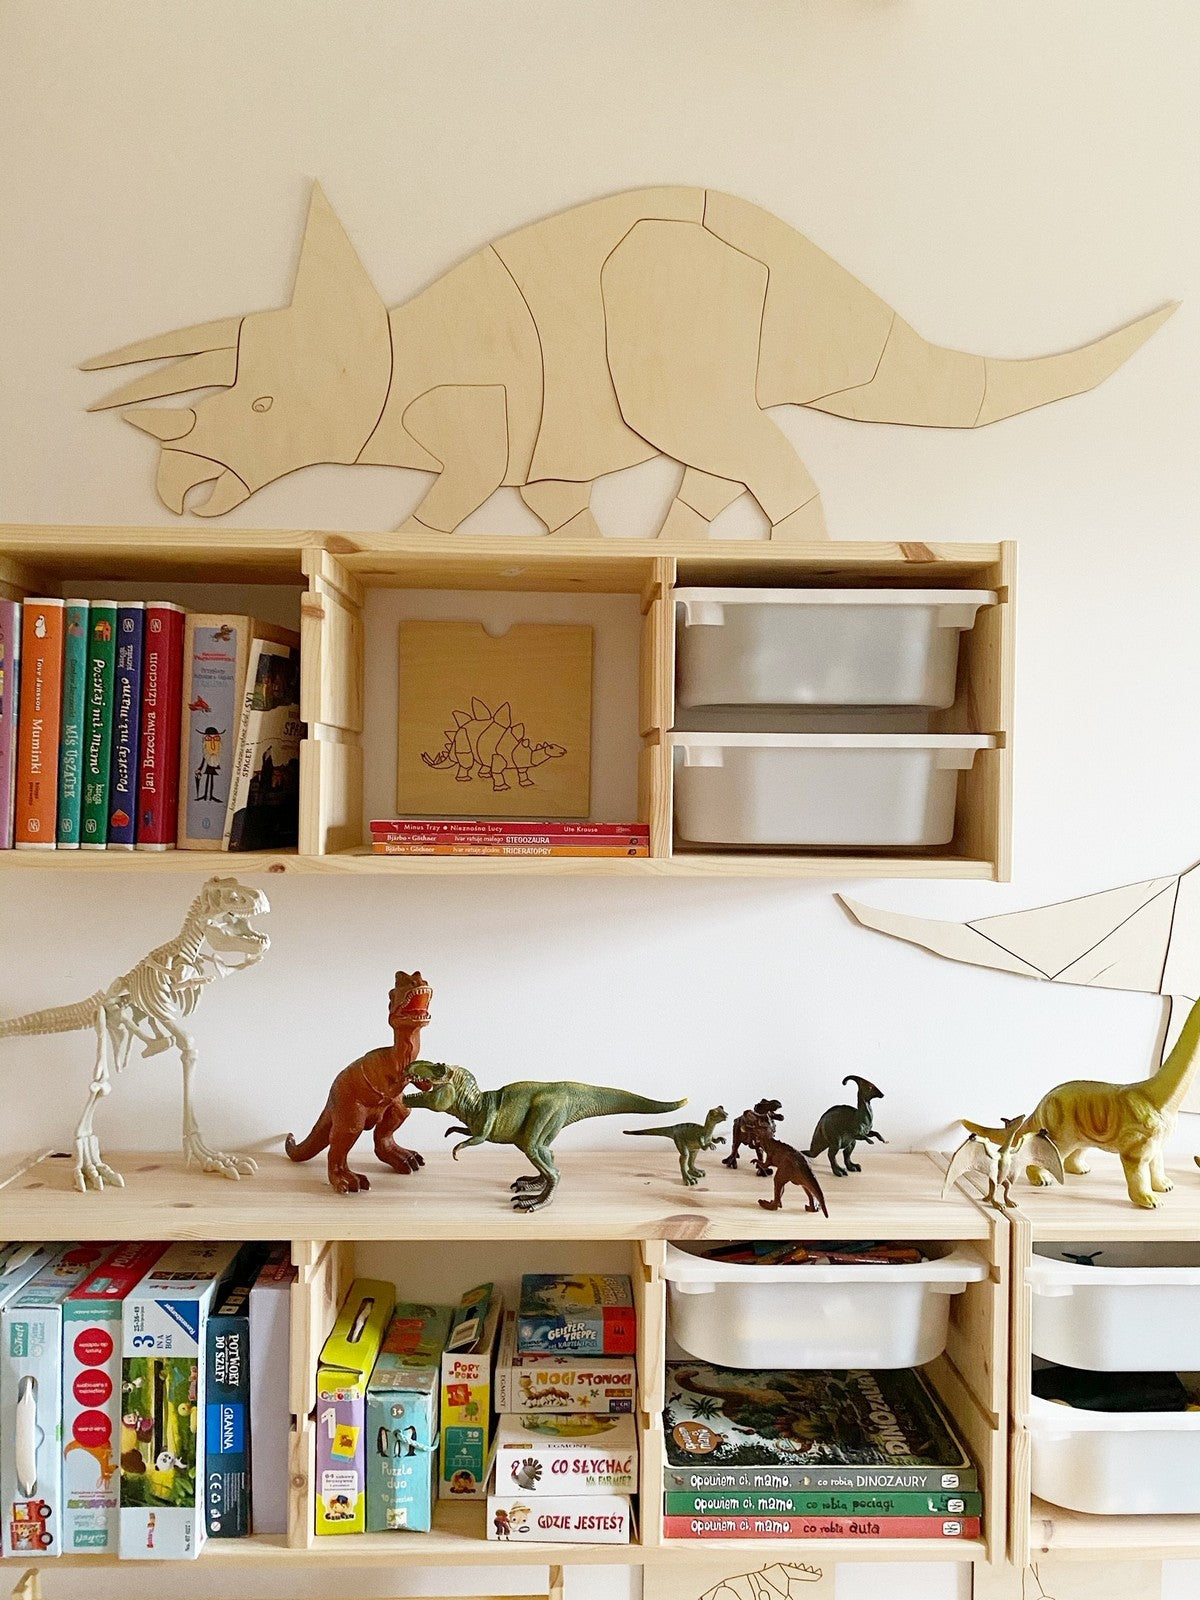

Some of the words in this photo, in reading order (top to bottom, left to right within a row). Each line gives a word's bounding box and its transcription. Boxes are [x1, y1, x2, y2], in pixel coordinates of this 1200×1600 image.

[92, 659, 106, 706] Poczytaj
[147, 652, 158, 706] dzieciom
[121, 677, 131, 717] mamo
[30, 718, 42, 774] Muminki
[144, 712, 156, 767] Brzechwa
[89, 734, 100, 775] mamo
[64, 749, 77, 798] USZATEK
[116, 745, 129, 792] Poczytaj
[142, 772, 156, 793] Jan
[488, 825, 503, 833] Lucy
[164, 1303, 195, 1335] Ravensburger
[547, 1322, 586, 1341] GEISTER
[563, 1329, 597, 1341] TREPPE
[133, 1335, 154, 1348] 3
[215, 1336, 224, 1349] DO
[215, 1352, 224, 1384] SZAFY
[229, 1334, 239, 1387] POTWORY
[454, 1361, 480, 1372] PORY
[536, 1371, 576, 1386] NOGI
[577, 1373, 632, 1386] STONOGI
[392, 1408, 403, 1416] 3+
[224, 1407, 234, 1450] GRANNA
[381, 1461, 413, 1476] Puzzle
[551, 1459, 568, 1474] CO
[572, 1456, 632, 1474] SŁYCHAĆ
[387, 1477, 407, 1489] duo
[586, 1476, 596, 1485] NA
[690, 1473, 736, 1490] opowiem
[754, 1474, 792, 1489] mamo,
[830, 1477, 853, 1487] robią
[856, 1475, 928, 1488] DINOZAURY
[694, 1496, 740, 1513] opowiem
[758, 1497, 796, 1512] mamo,
[806, 1501, 818, 1509] co
[822, 1498, 847, 1510] robią
[537, 1515, 571, 1529] GDZIE
[574, 1512, 624, 1533] JESTEŚ?
[690, 1519, 736, 1535] opowiem
[754, 1520, 793, 1534] mamo,
[803, 1525, 816, 1533] co
[849, 1522, 880, 1534] auta
